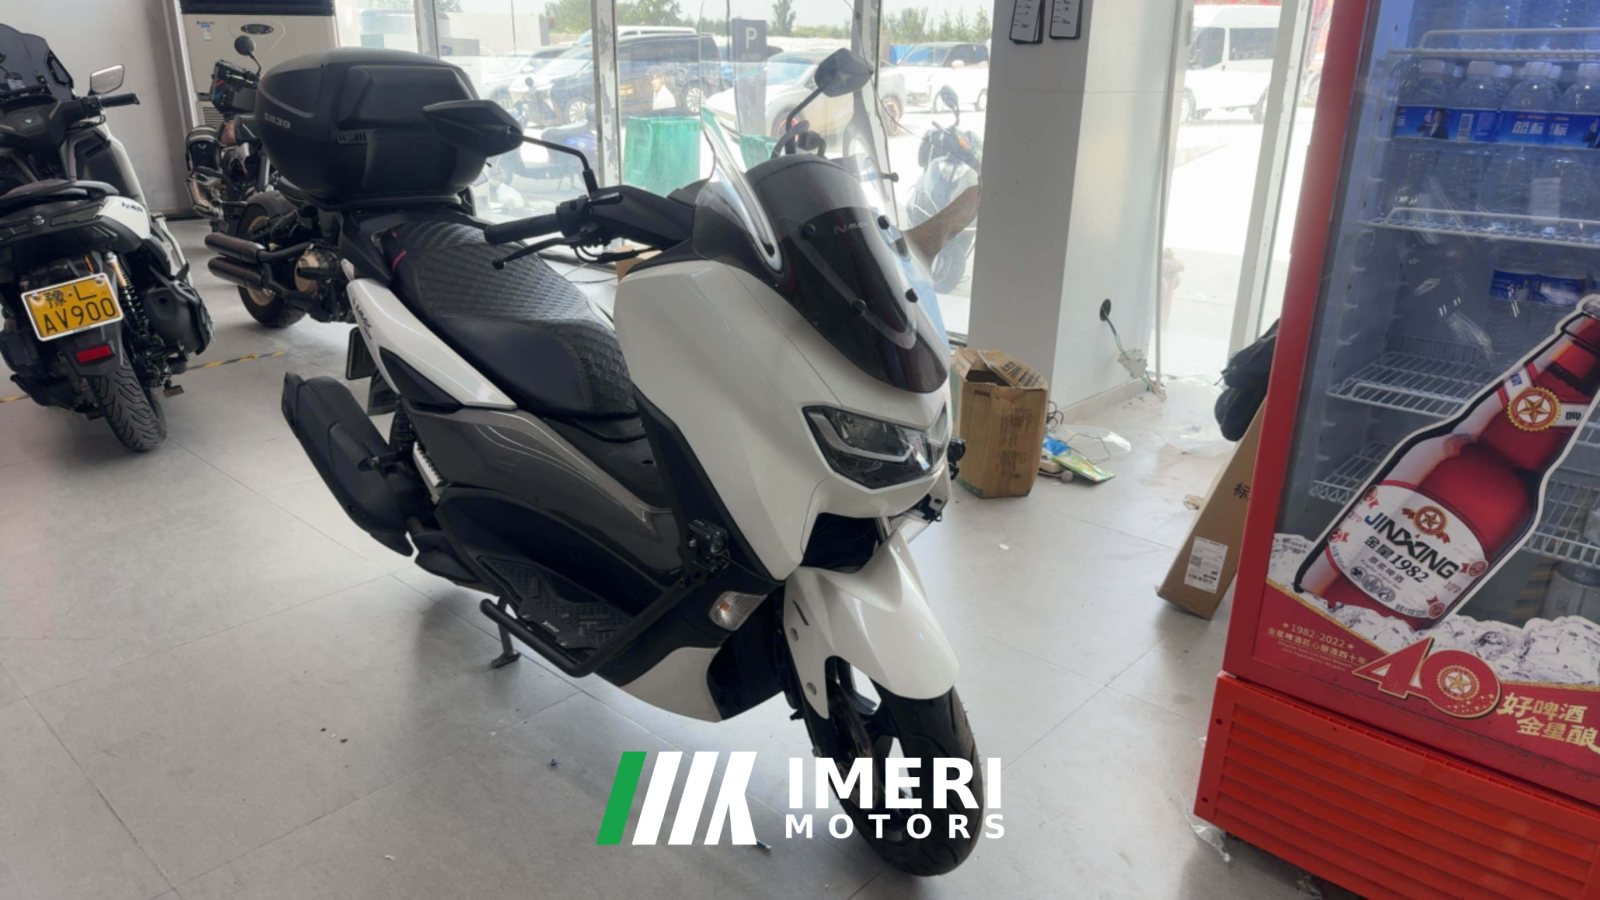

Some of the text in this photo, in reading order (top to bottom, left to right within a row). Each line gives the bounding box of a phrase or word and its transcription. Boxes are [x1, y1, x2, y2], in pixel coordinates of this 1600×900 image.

[745, 27, 757, 49] P
[43, 297, 116, 334] AV900
[1364, 512, 1460, 580] JINXING
[1496, 692, 1588, 723] 好啤酒
